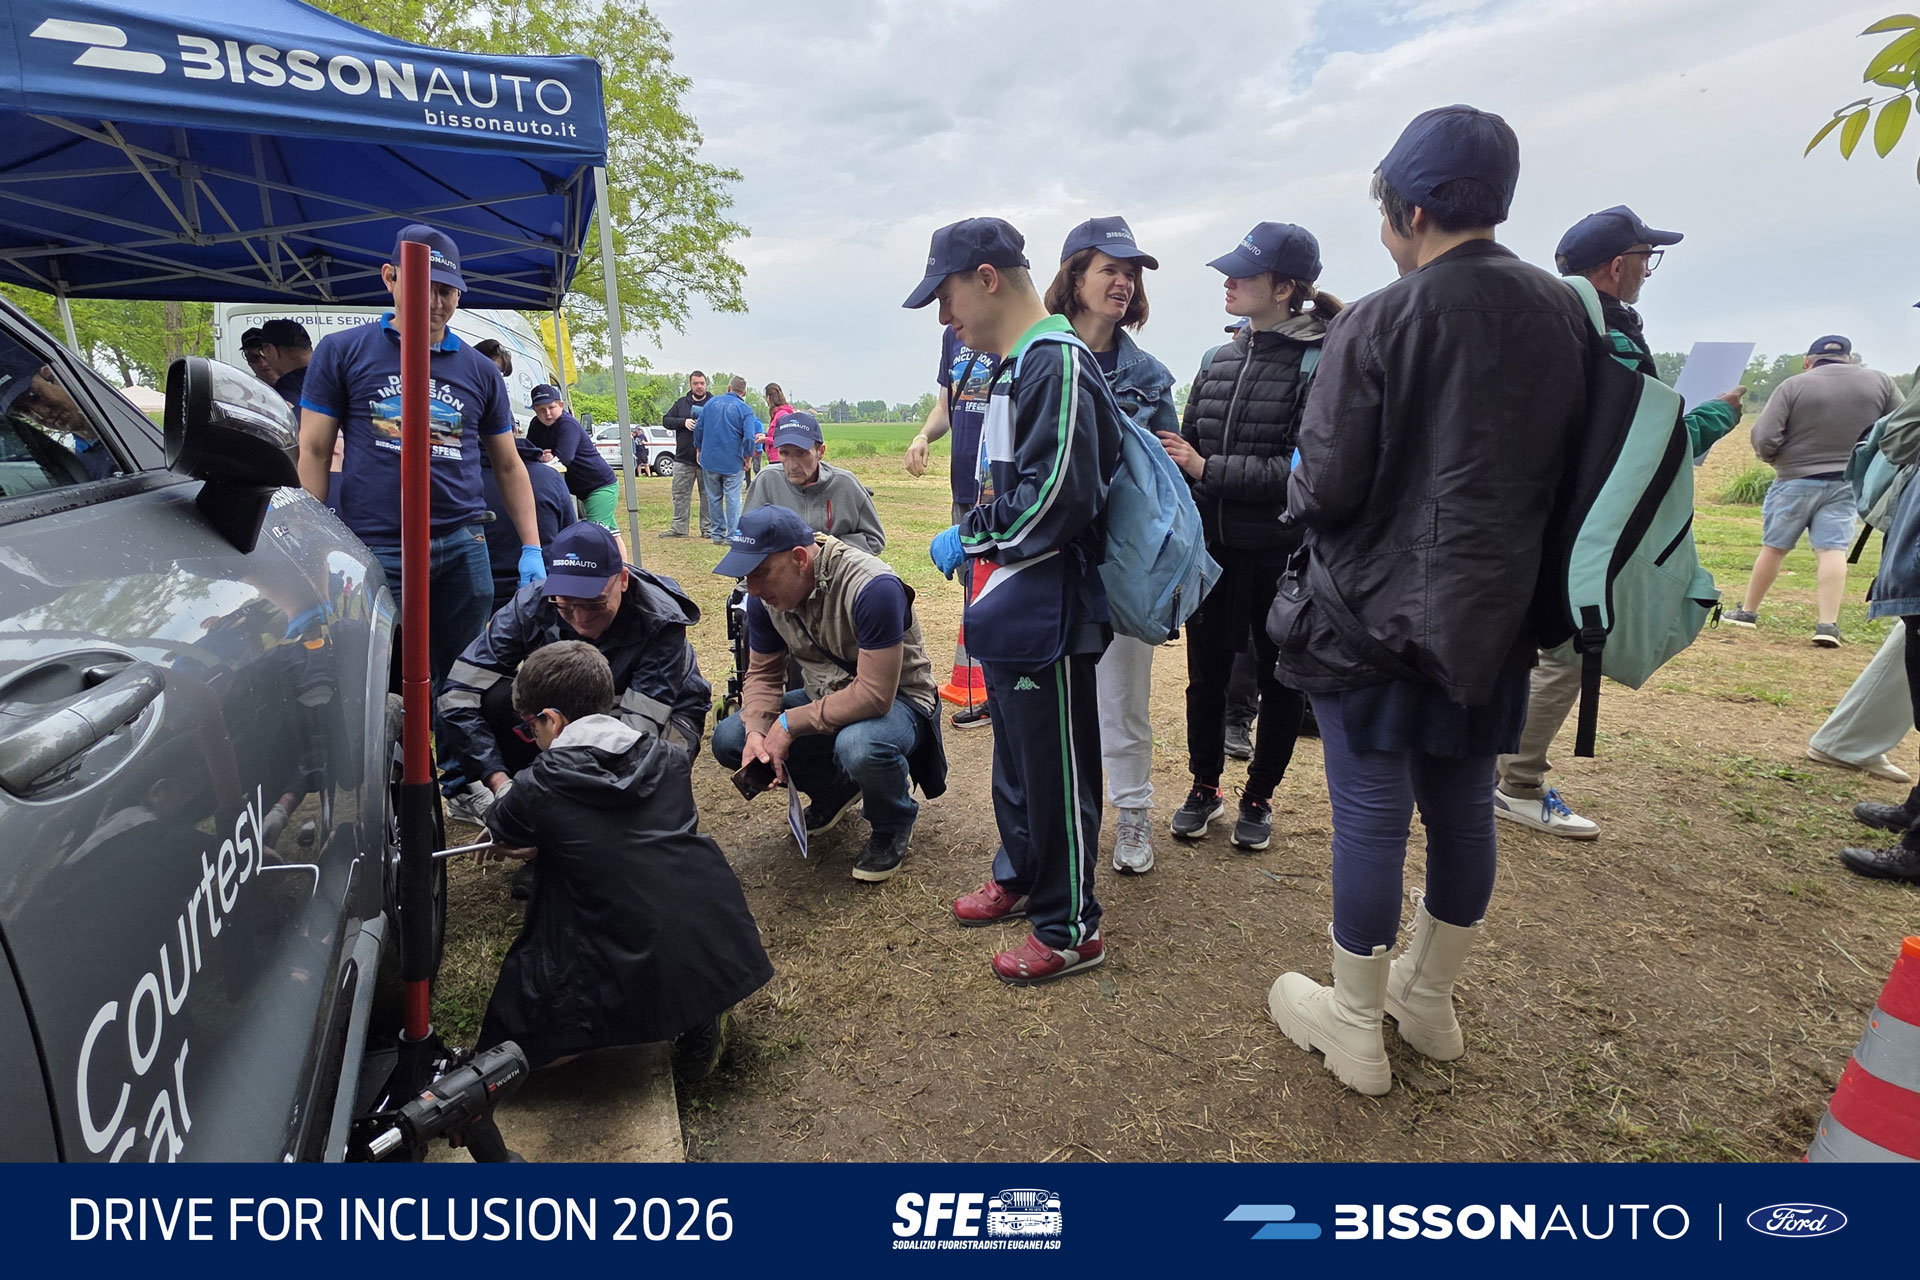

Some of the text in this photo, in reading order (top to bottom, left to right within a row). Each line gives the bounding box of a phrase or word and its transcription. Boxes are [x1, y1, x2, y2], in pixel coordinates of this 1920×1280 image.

[177, 34, 572, 116] BISSONAUTO
[424, 108, 577, 137] bissonauto.it
[77, 784, 263, 1154] Courtesy
